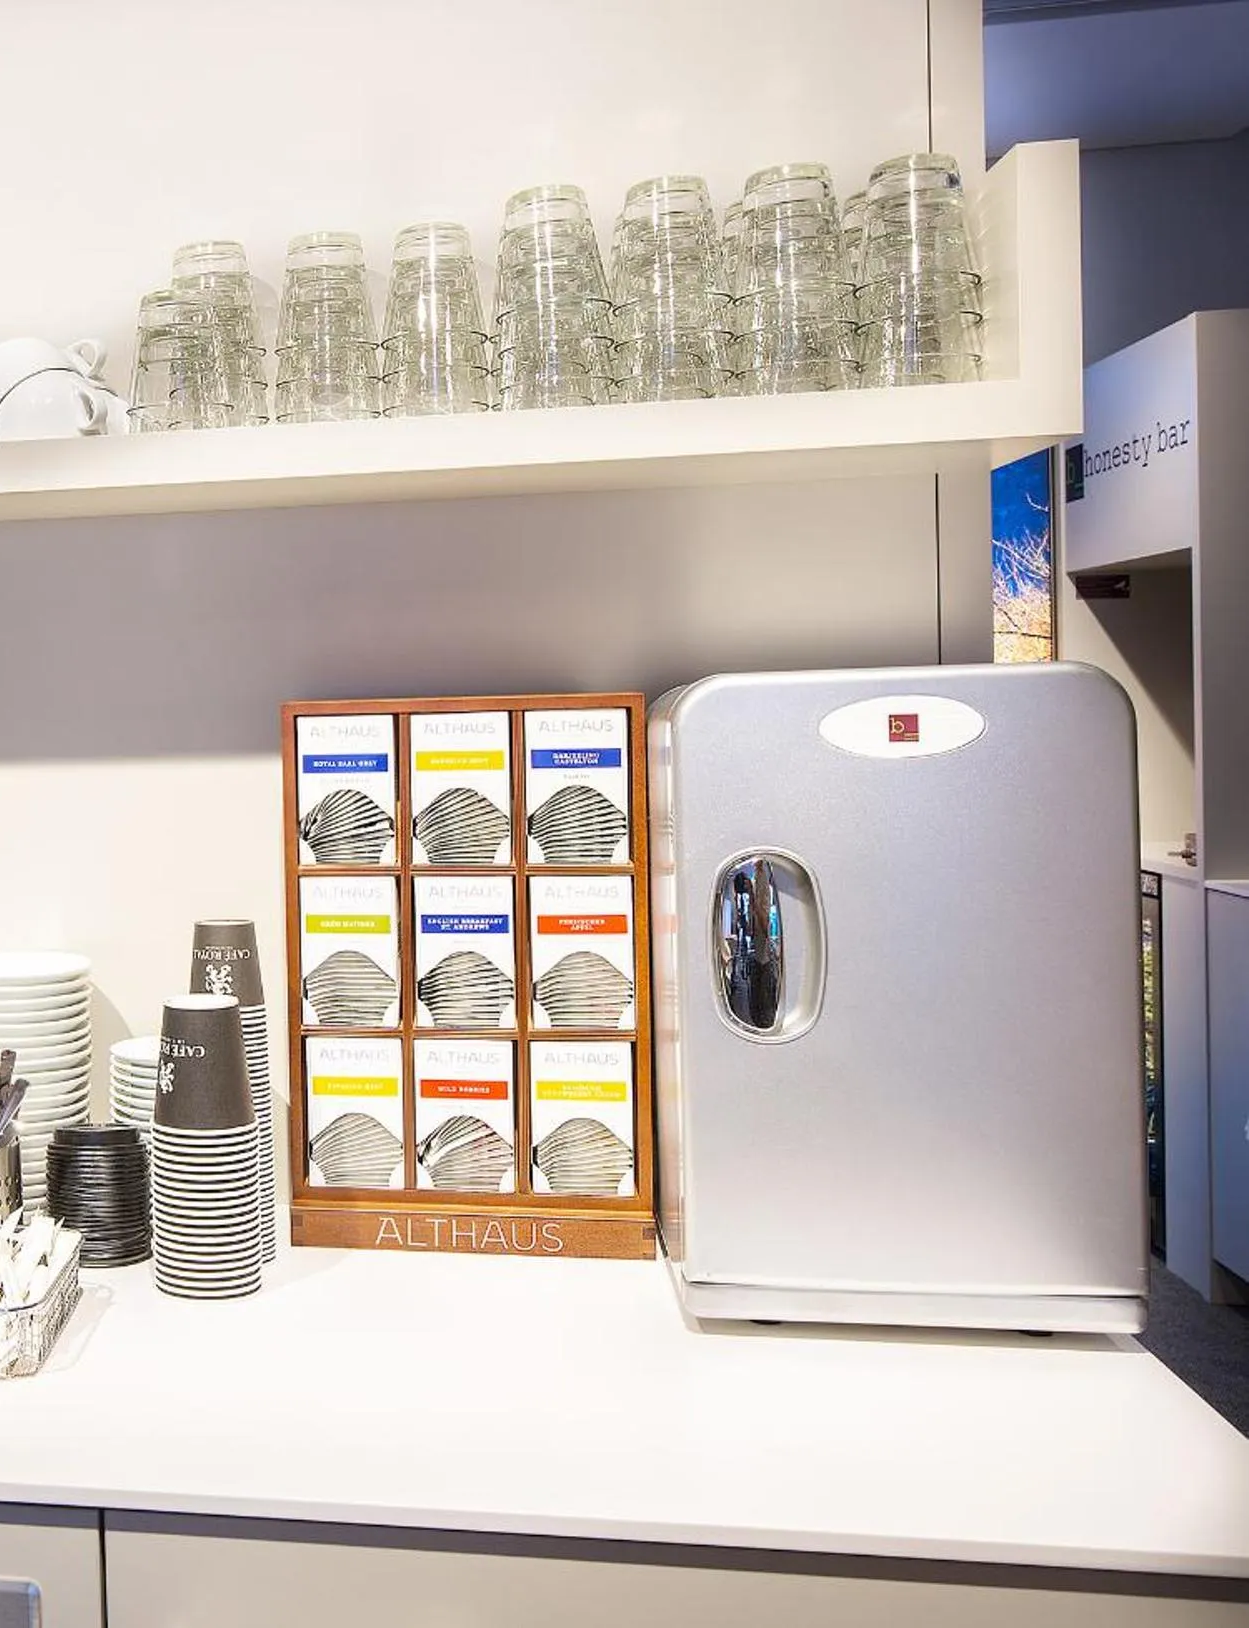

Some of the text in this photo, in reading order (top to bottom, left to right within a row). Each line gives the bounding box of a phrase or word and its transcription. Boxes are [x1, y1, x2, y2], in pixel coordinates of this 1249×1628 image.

[1084, 434, 1152, 478] honesty
[1156, 421, 1190, 453] bar
[310, 724, 381, 738] ALTHAUS
[423, 722, 496, 735] ALTHAUS
[539, 719, 615, 732] ALTHAUS
[429, 885, 503, 899] ALTHAUS
[544, 885, 620, 900] ALTHAUS
[171, 1044, 206, 1059] CAFÉ
[320, 1047, 390, 1061] ALTHAUS
[427, 1050, 501, 1065] ALTHAUS
[544, 1051, 620, 1066] ALTHAUS
[375, 1216, 564, 1252] ALTHAUS
